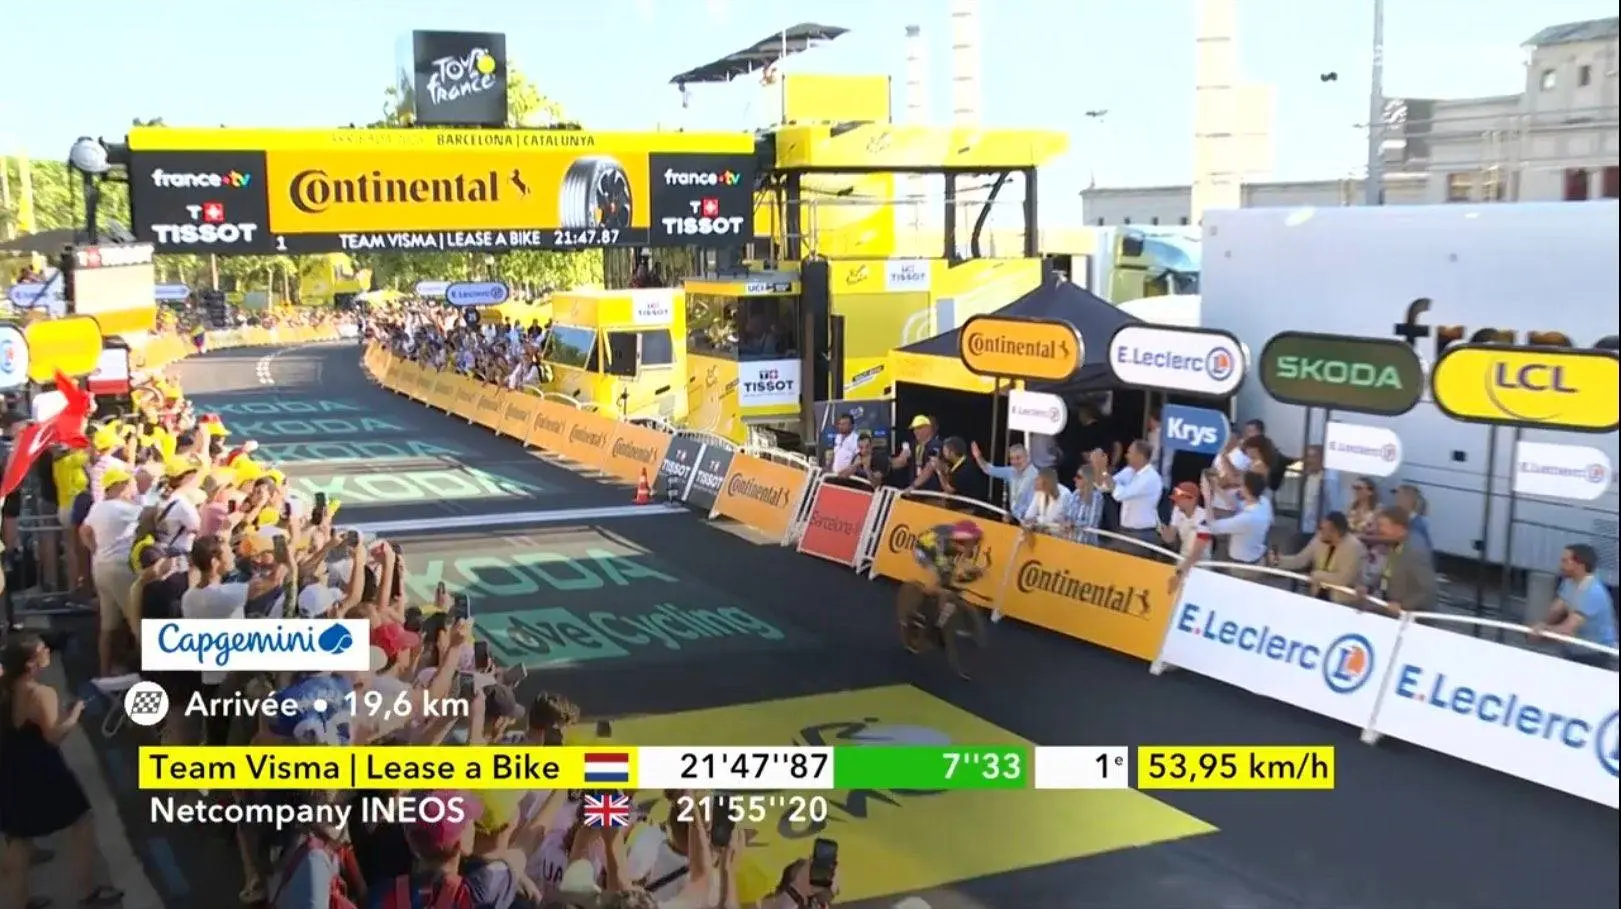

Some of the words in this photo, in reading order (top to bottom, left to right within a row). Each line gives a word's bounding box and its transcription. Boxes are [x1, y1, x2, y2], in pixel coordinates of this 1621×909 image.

[437, 134, 513, 146] BARCELONA
[523, 134, 595, 146] CATALUNYA
[290, 169, 499, 214] Continental
[152, 223, 257, 244] TISSOT
[276, 235, 287, 251] 1
[338, 233, 388, 249] TEAM
[388, 233, 437, 249] VISMA
[447, 232, 496, 247] LEASE
[495, 232, 506, 246] A
[510, 231, 541, 246] BIKE
[554, 229, 620, 245] 21:47.87
[662, 217, 744, 235] TISSOT
[968, 331, 1057, 360] Continental
[1117, 345, 1204, 371] E.Leclerc
[743, 380, 795, 393] TISSOT
[1495, 361, 1579, 394] LCL
[202, 398, 360, 415] KODA
[231, 416, 405, 436] KODA
[1167, 416, 1218, 447] Krys
[300, 468, 544, 502] KODA
[727, 472, 784, 508] Continental
[403, 547, 681, 602] KODA
[1017, 558, 1136, 615] Continental
[588, 603, 786, 651] Cycling
[1177, 601, 1321, 671] E.Leclerc
[1395, 664, 1592, 749] E.Leclerc
[542, 859, 563, 883] UA
